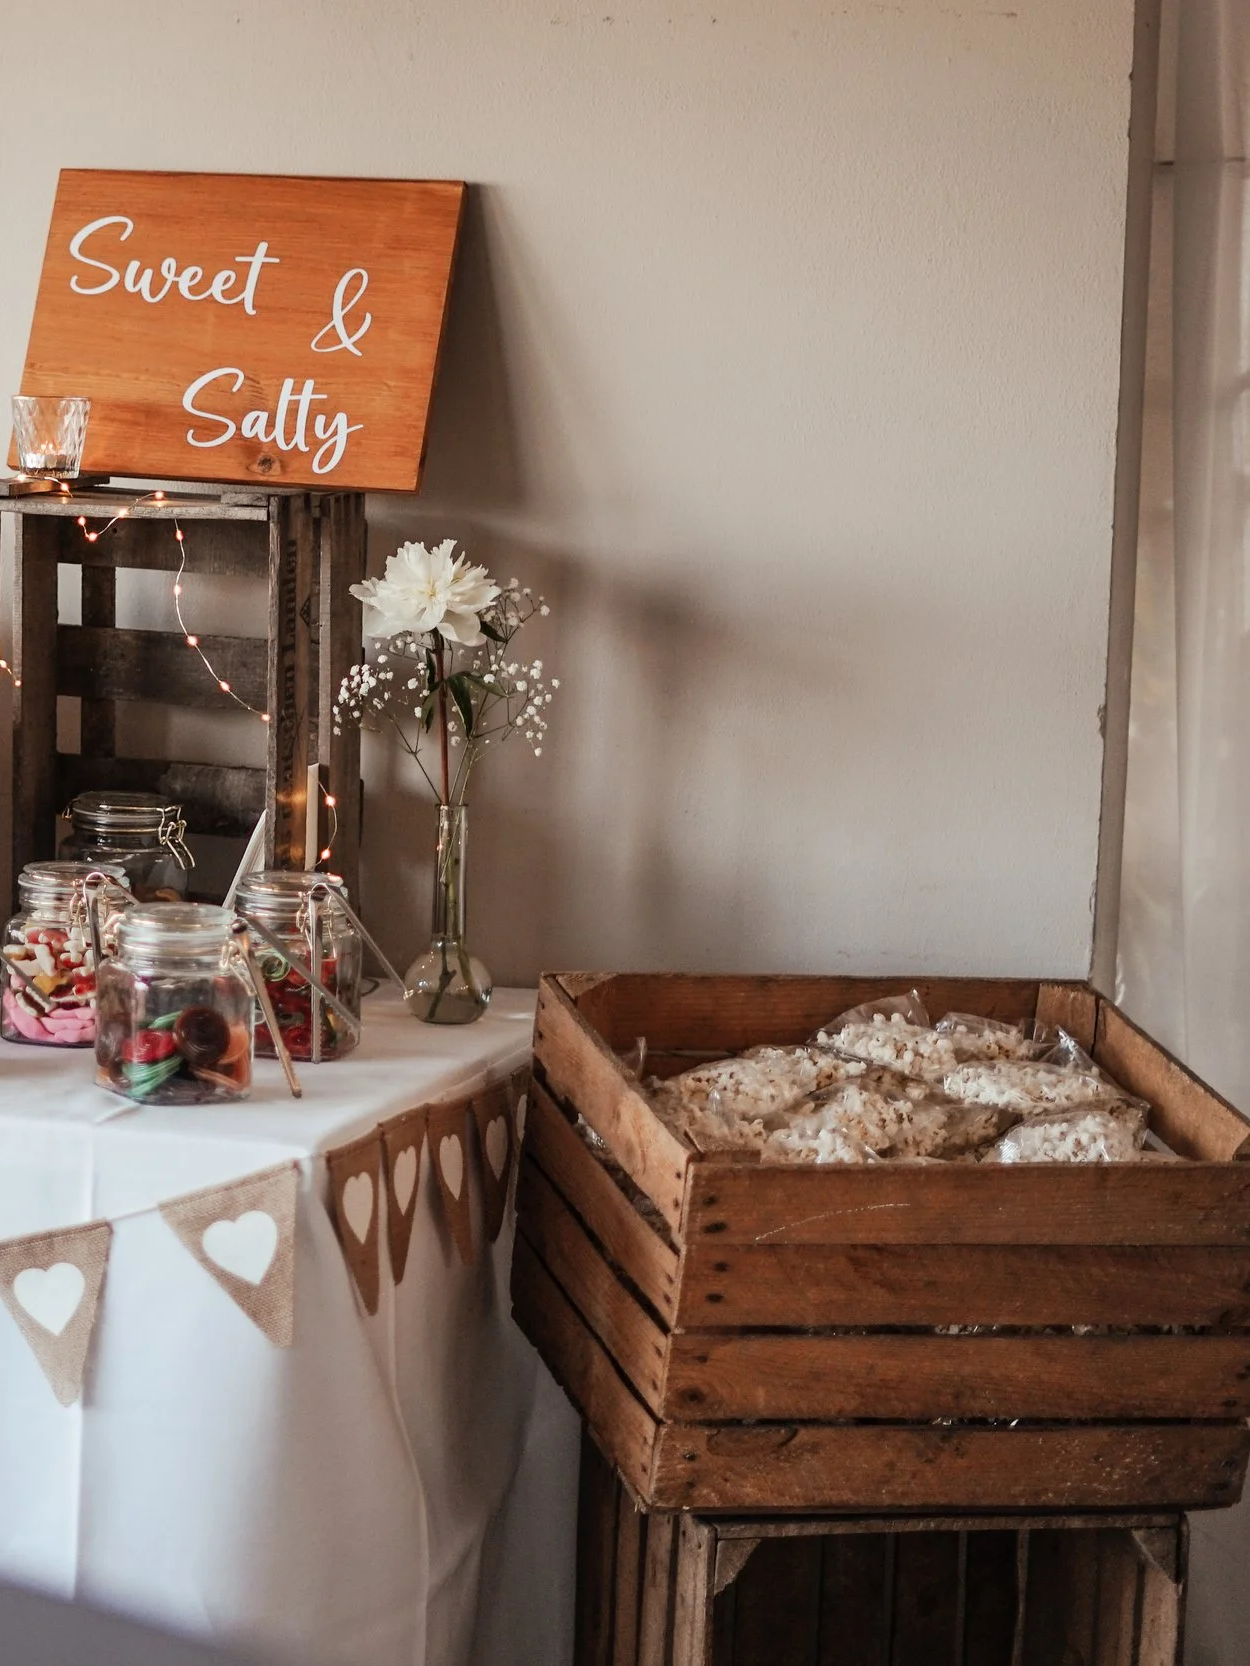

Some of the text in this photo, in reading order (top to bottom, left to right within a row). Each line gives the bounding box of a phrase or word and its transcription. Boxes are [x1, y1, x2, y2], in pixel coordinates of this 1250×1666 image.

[69, 215, 372, 357] Sweet &
[182, 366, 364, 475] Salty
